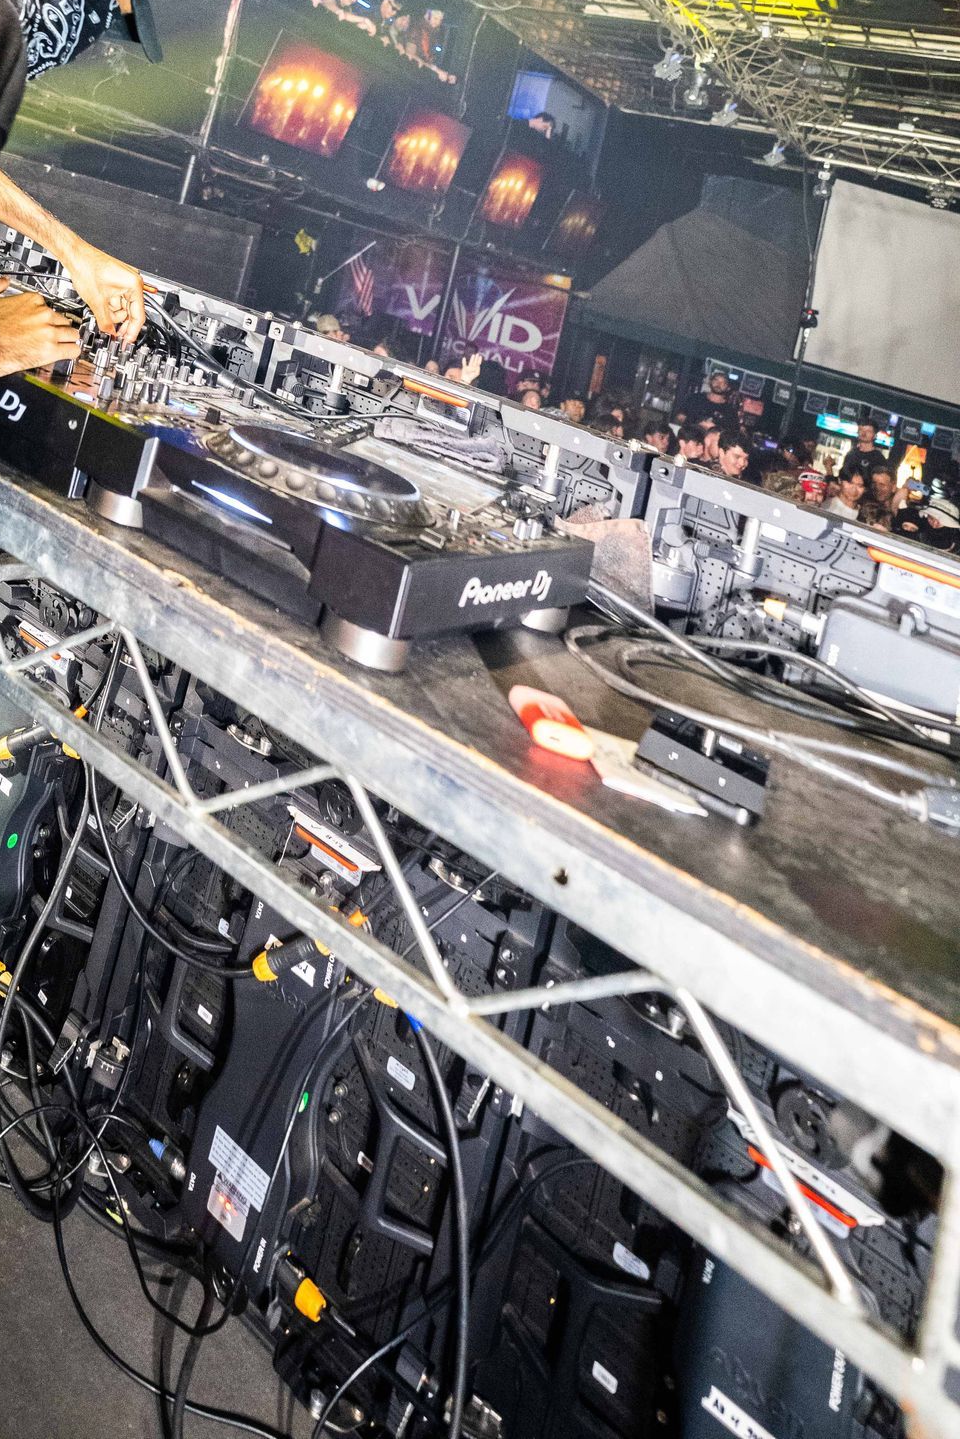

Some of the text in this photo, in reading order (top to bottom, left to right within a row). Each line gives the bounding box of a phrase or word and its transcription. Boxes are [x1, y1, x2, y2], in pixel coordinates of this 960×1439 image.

[457, 576, 533, 608] Pioneer
[255, 901, 264, 919] DATA
[323, 963, 334, 989] POWER
[188, 1171, 197, 1192] DATA
[253, 1248, 265, 1273] POWER
[828, 1372, 844, 1413] POWER
